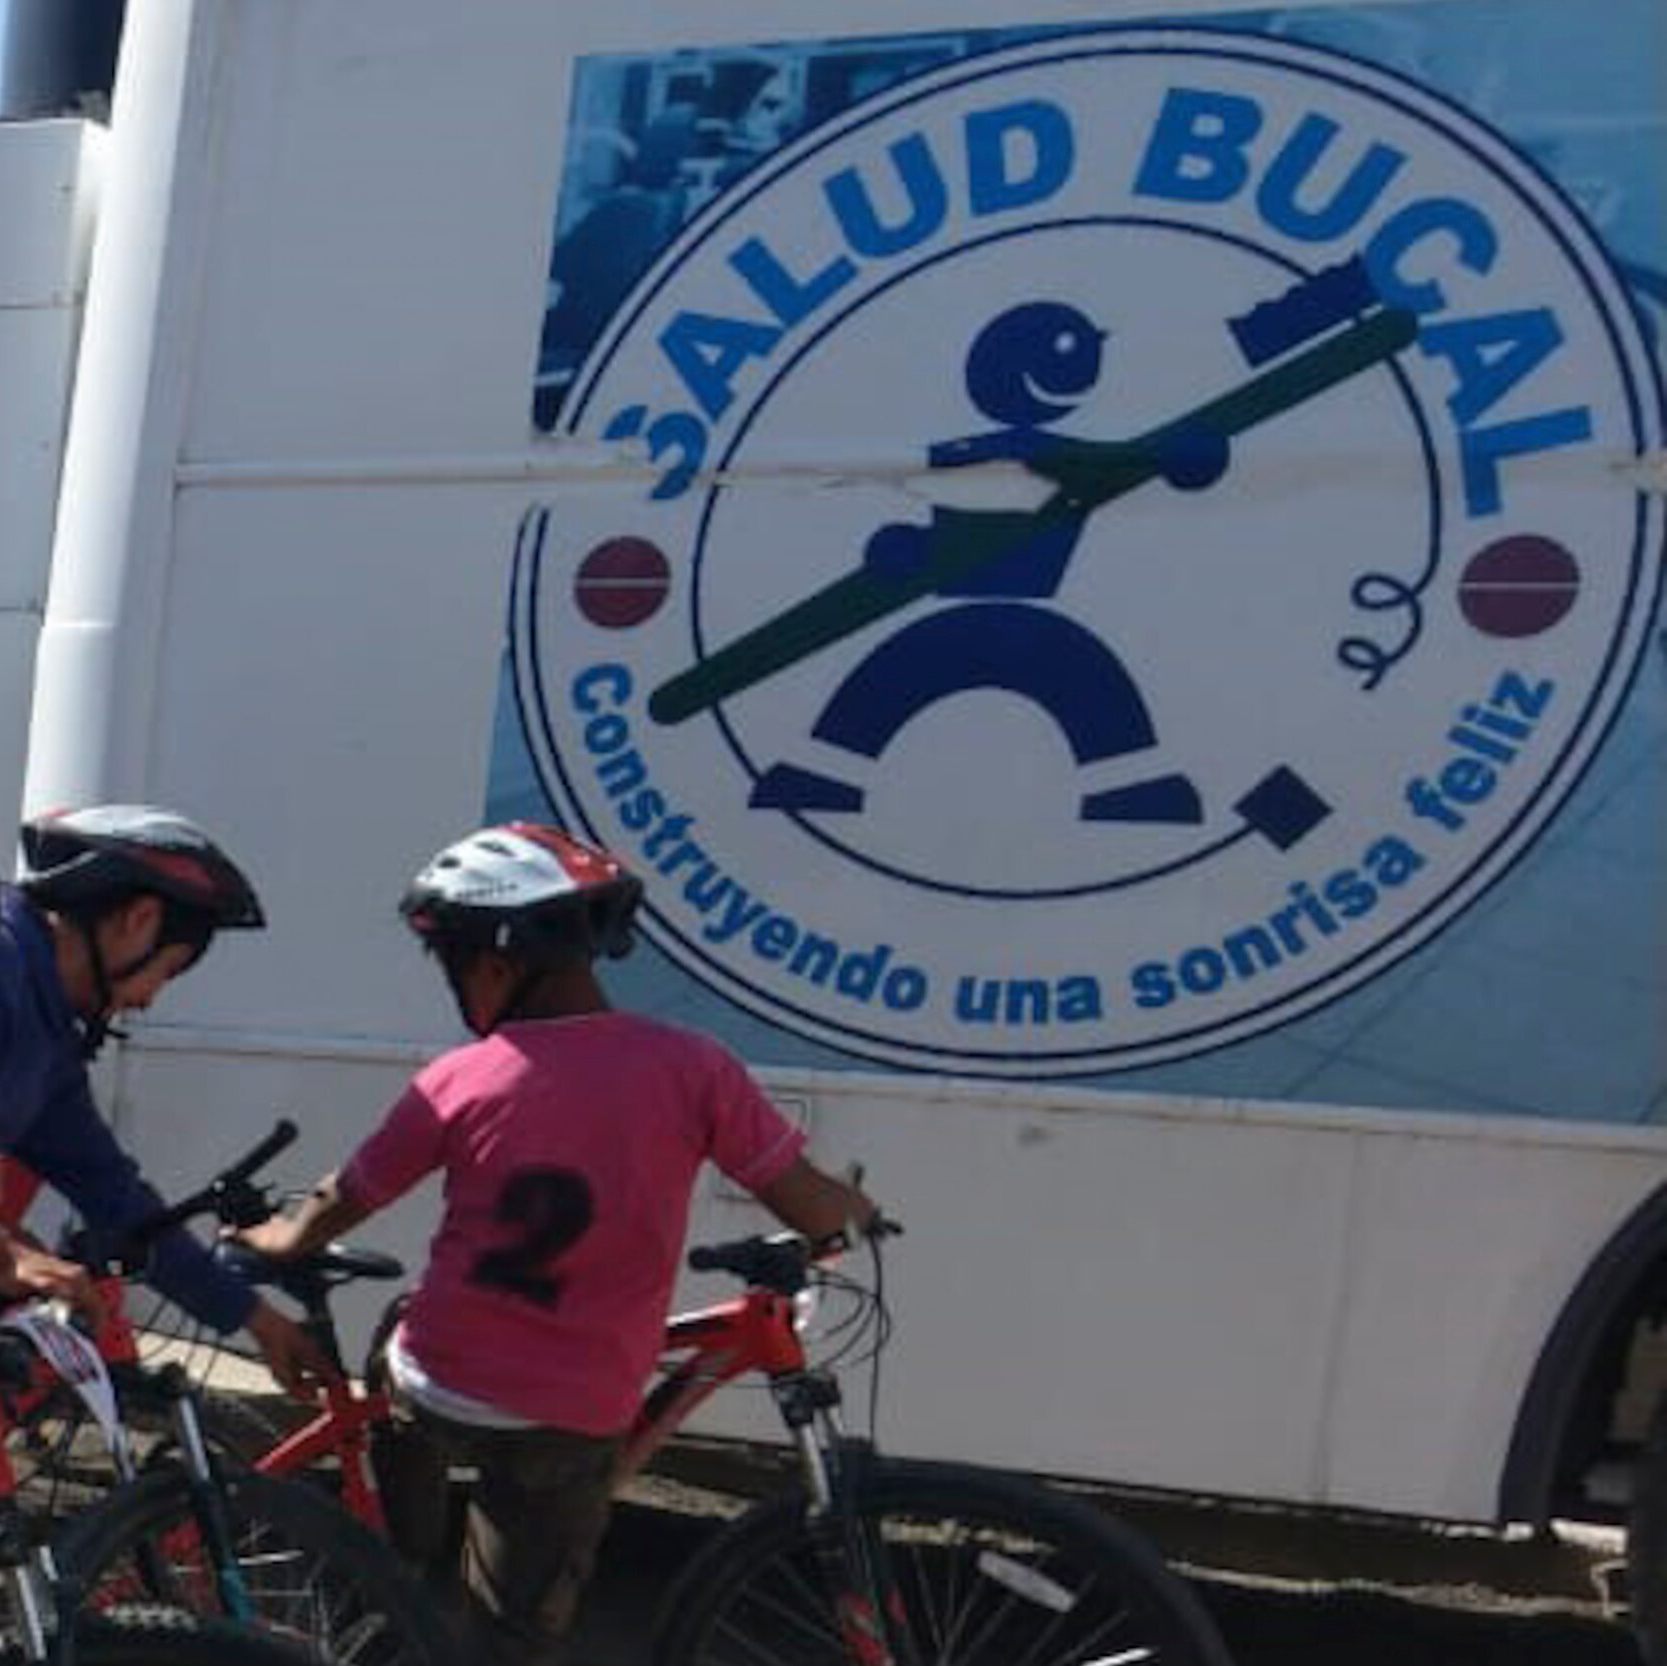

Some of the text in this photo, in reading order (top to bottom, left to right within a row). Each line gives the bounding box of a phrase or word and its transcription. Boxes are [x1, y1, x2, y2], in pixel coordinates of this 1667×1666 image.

[601, 87, 1593, 518] SALUD BUCAL
[570, 661, 1555, 1027] Construyendo una sonrisa feliz
[471, 1166, 597, 1315] 2
